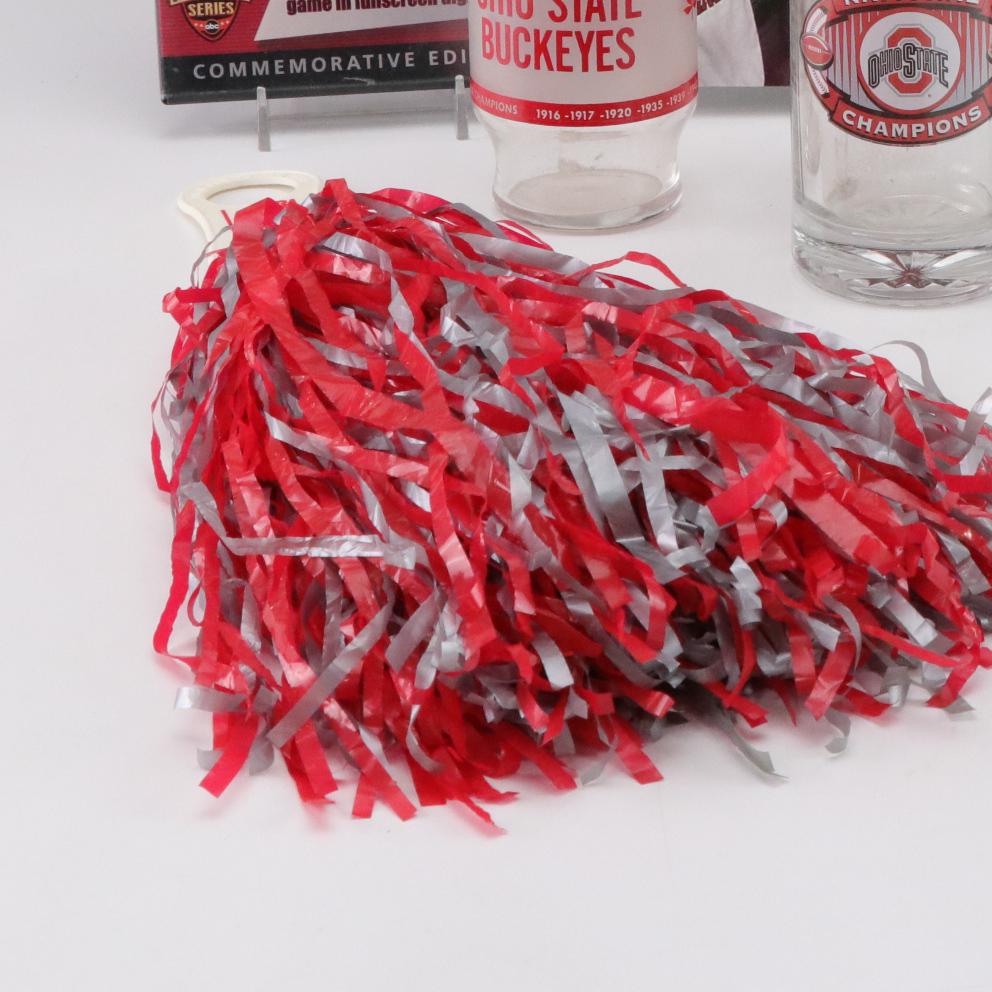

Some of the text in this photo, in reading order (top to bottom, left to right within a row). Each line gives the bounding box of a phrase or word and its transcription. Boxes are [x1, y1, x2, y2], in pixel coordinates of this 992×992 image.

[187, 2, 234, 16] SERIES
[481, 16, 636, 73] BUCKEYES
[193, 51, 415, 80] COMMEMORATIVE
[536, 109, 561, 120] 1916
[841, 105, 982, 138] CHAMPIONS
